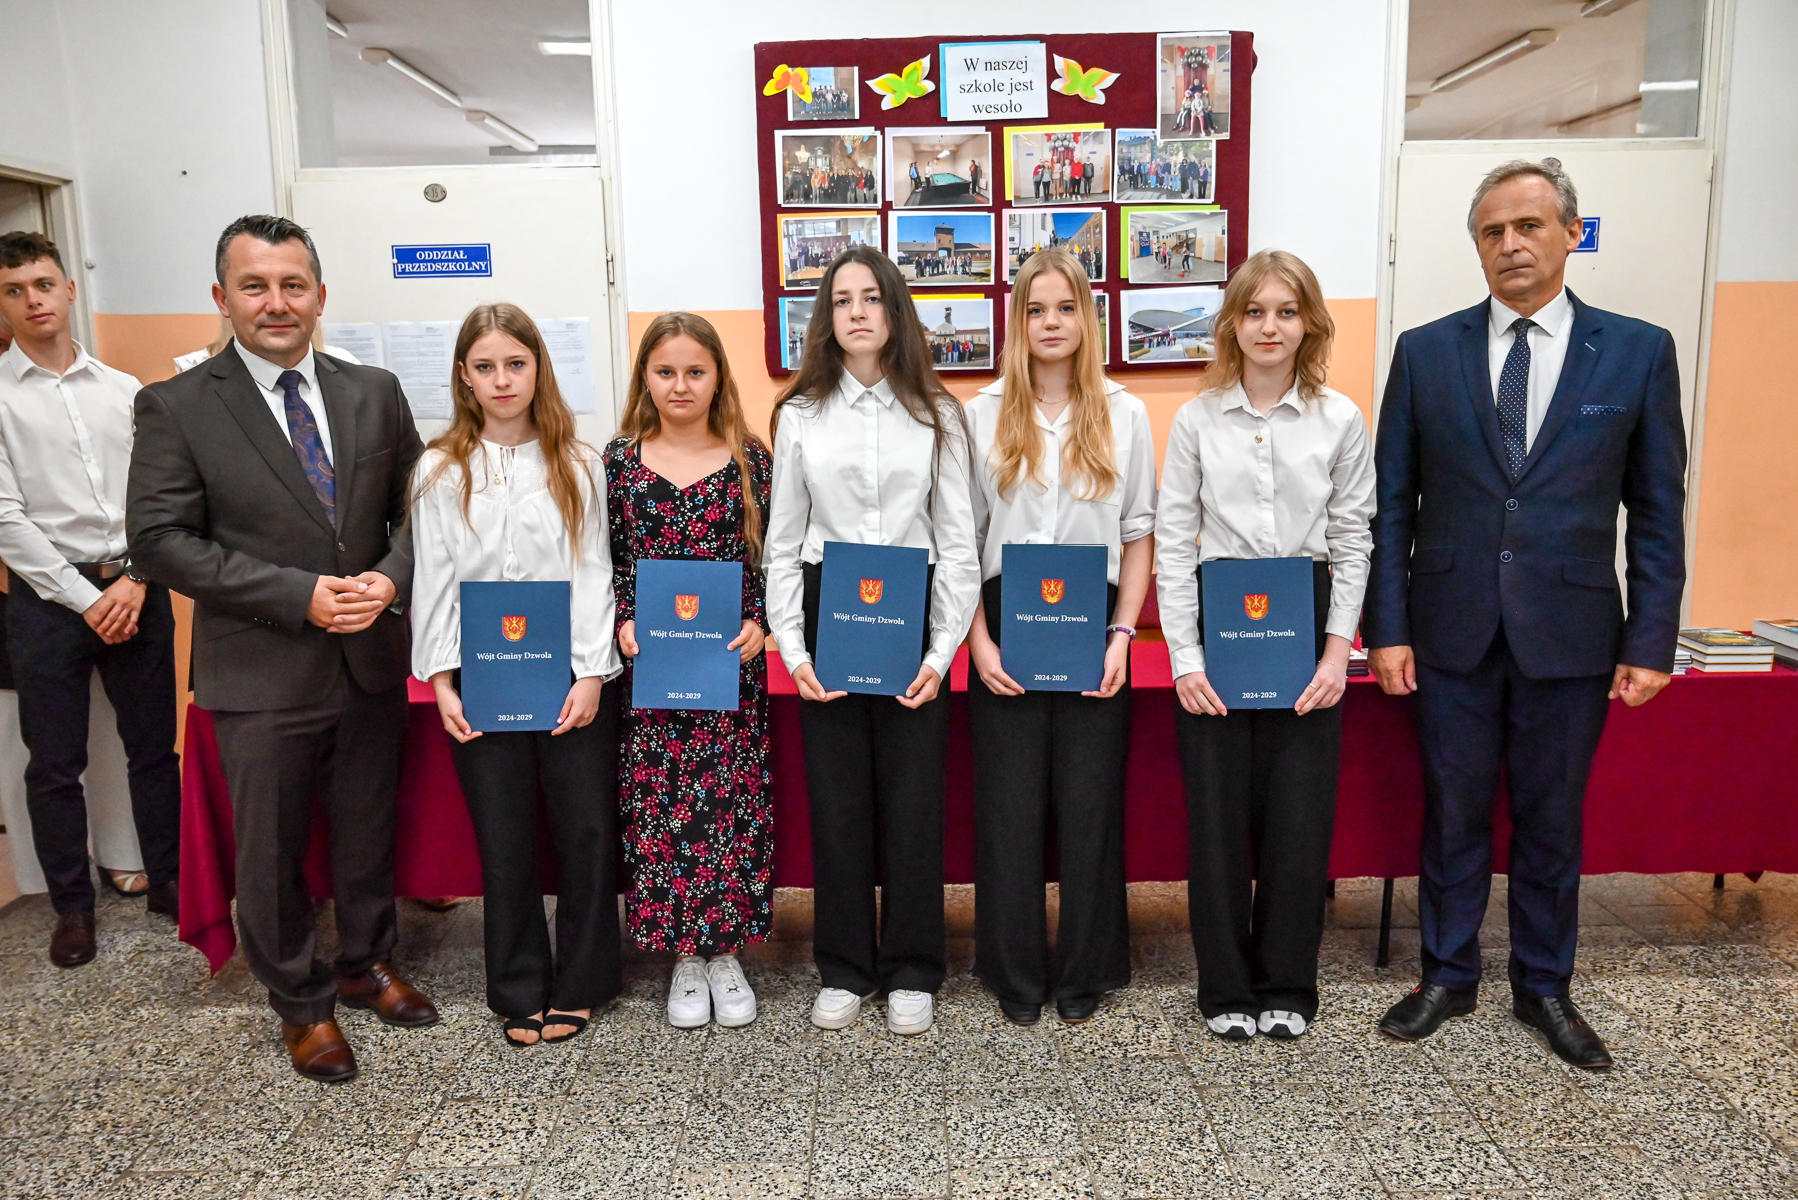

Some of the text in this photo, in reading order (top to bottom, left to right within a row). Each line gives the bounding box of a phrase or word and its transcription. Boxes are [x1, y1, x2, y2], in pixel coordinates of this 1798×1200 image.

[964, 56, 1028, 73] W naszej
[959, 78, 1034, 95] szkole jest
[972, 99, 1022, 114] wesoło
[416, 250, 467, 260] ODDZIAŁ
[397, 261, 487, 272] PRZEDSZKOLNY
[832, 612, 905, 625] Wójt Gminy Dzwola
[1016, 614, 1034, 623] Wójt
[1034, 614, 1060, 624] Gminy
[649, 630, 723, 640] Wójt Gminy Dzwola
[1219, 629, 1295, 640] Wójt Gminy Dzwola
[476, 651, 552, 662] Wójt Gminy Dzwola
[847, 676, 882, 684] 2024-2029
[1241, 691, 1277, 699] 2024-2029
